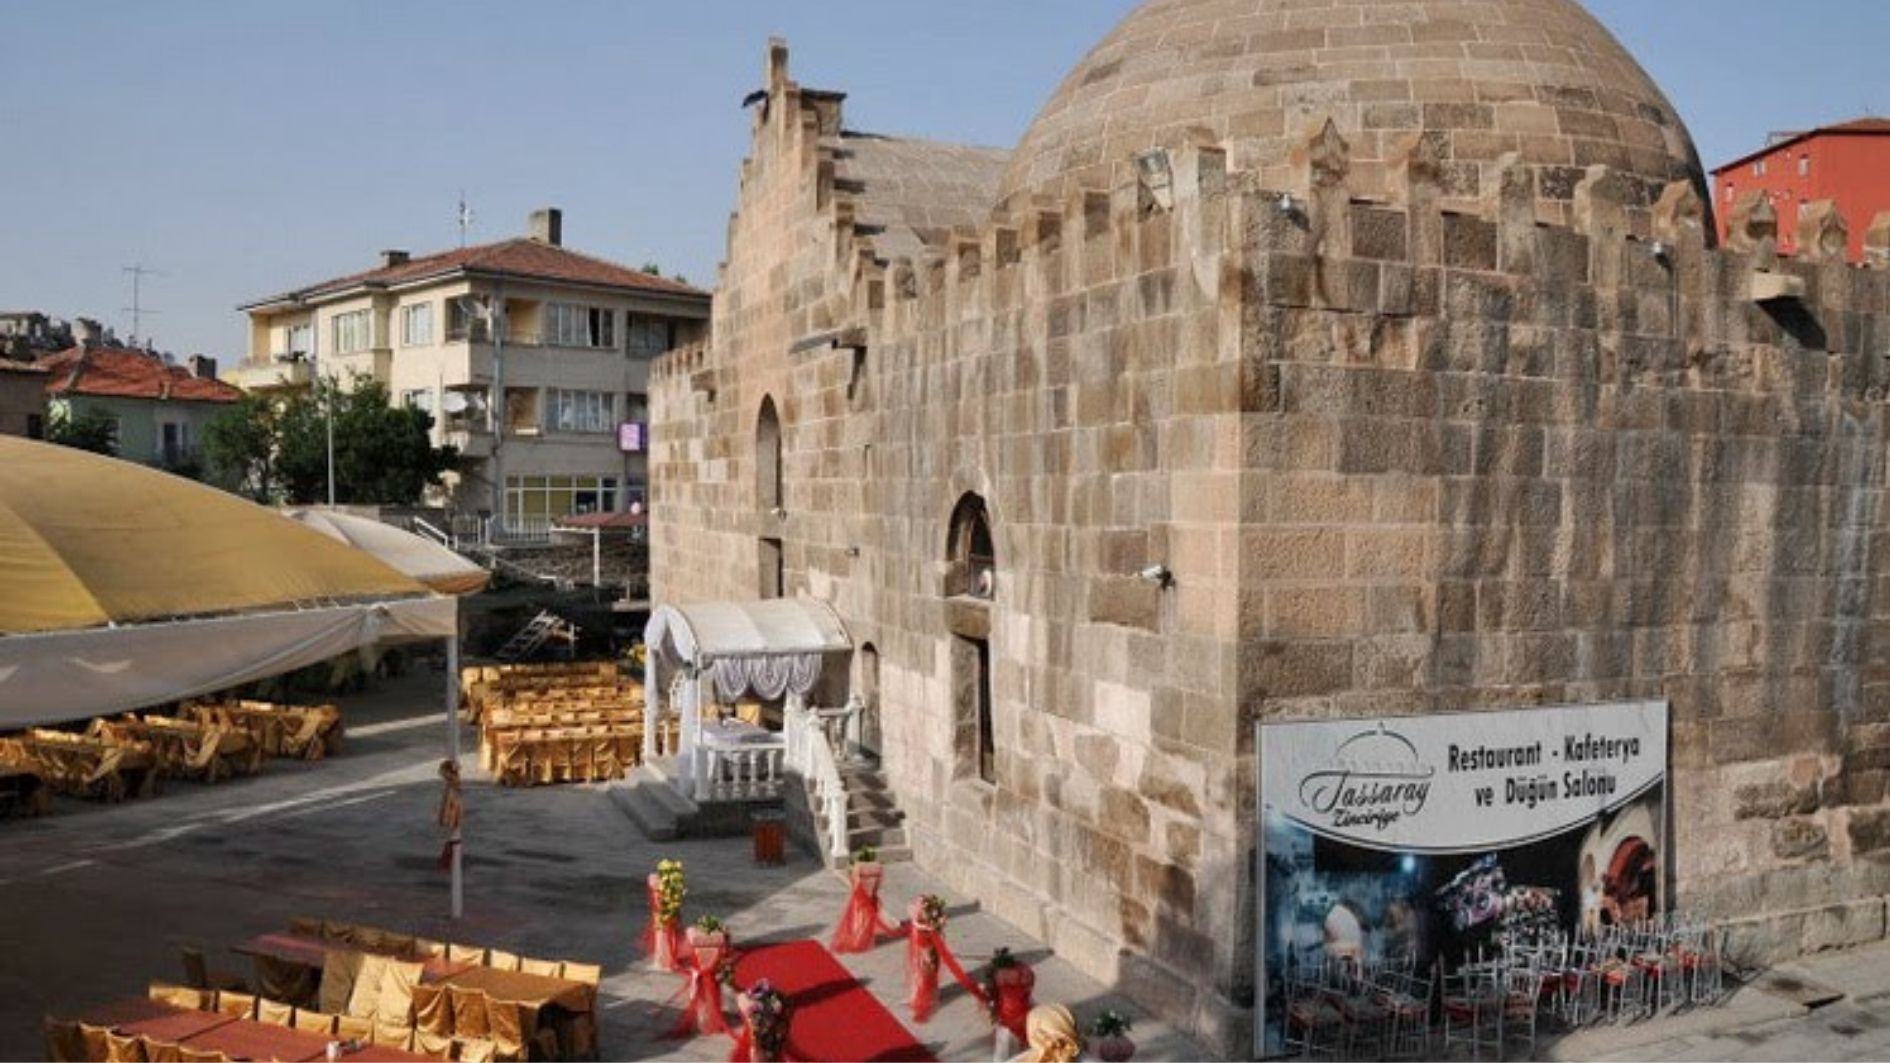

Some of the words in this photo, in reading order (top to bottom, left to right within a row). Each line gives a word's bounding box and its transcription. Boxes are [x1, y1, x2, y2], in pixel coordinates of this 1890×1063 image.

[1448, 741, 1542, 773] Restaurant
[1564, 732, 1640, 764] Kafeterya
[1474, 786, 1495, 807] ve
[1505, 773, 1558, 809] Düğün
[1563, 768, 1616, 799] Salonu
